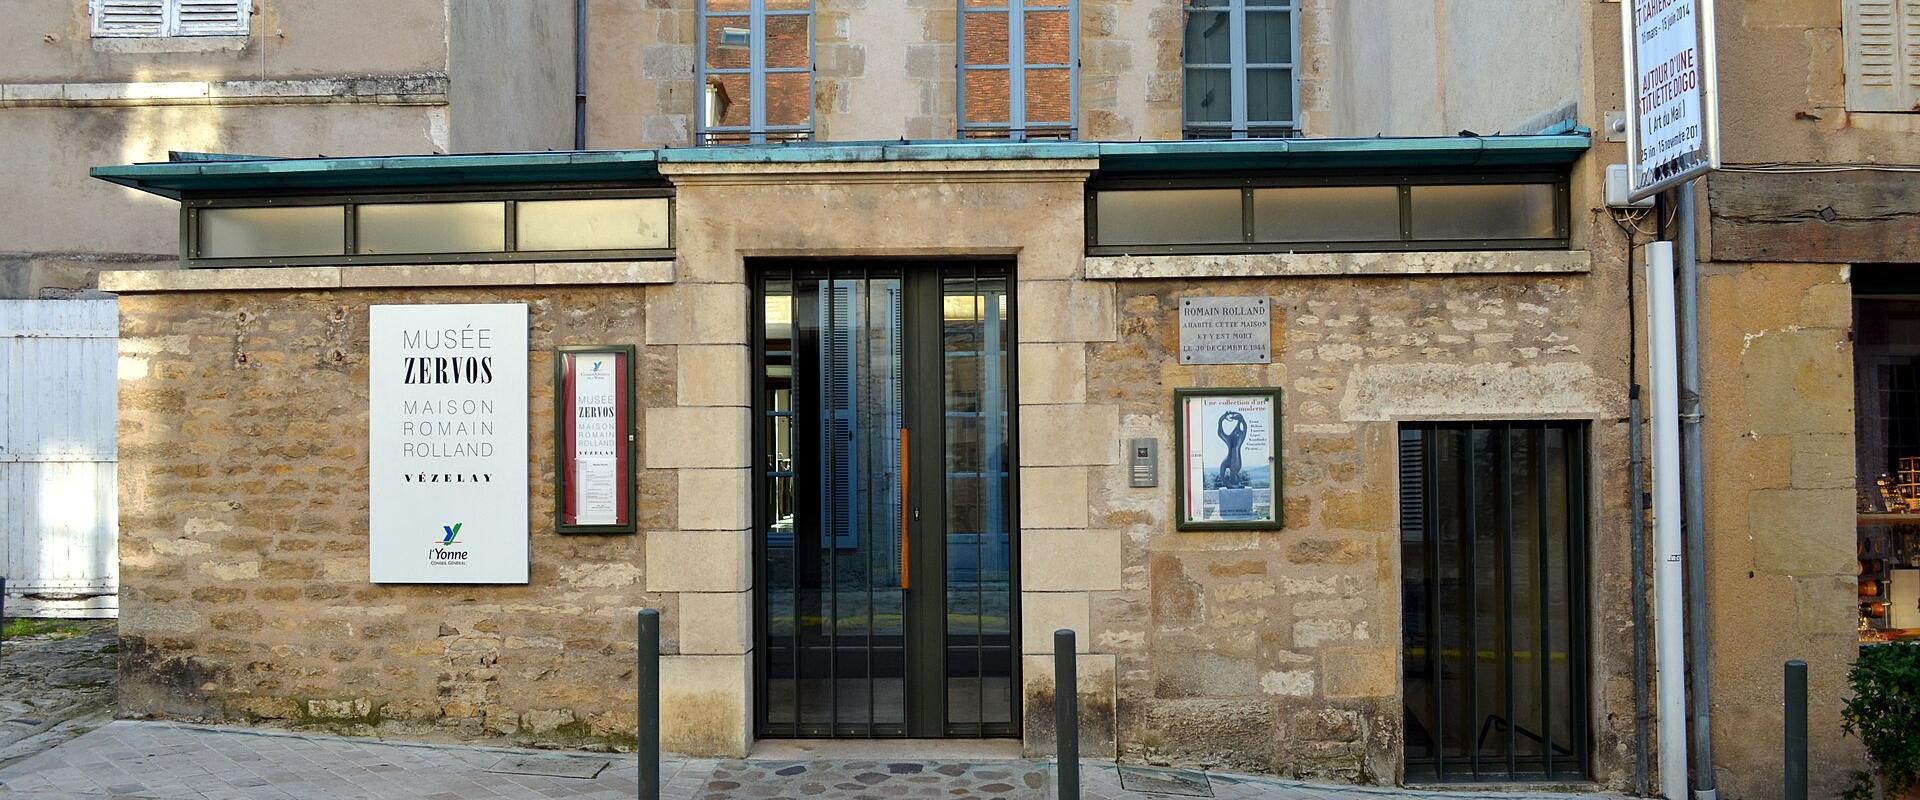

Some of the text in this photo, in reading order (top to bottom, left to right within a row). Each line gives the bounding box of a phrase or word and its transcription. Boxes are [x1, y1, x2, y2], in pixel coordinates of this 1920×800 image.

[1676, 3, 1690, 21] 2014
[1669, 48, 1694, 77] D'UNE
[1653, 115, 1662, 133] Art
[1658, 139, 1665, 153] 15
[1184, 306, 1265, 316] ROMAIN ROLLAND
[403, 320, 492, 349] MUSÉE
[403, 356, 493, 385] ZERVOS
[578, 393, 614, 405] MUSÉE
[403, 399, 493, 415] MAISON
[578, 406, 614, 418] ZERVOS
[403, 421, 493, 436] ROMAIN
[403, 442, 493, 457] ROLLAND
[578, 439, 614, 447] ROLLAND
[403, 471, 493, 483] VÉZELAY
[429, 548, 468, 560] l'Yonne
